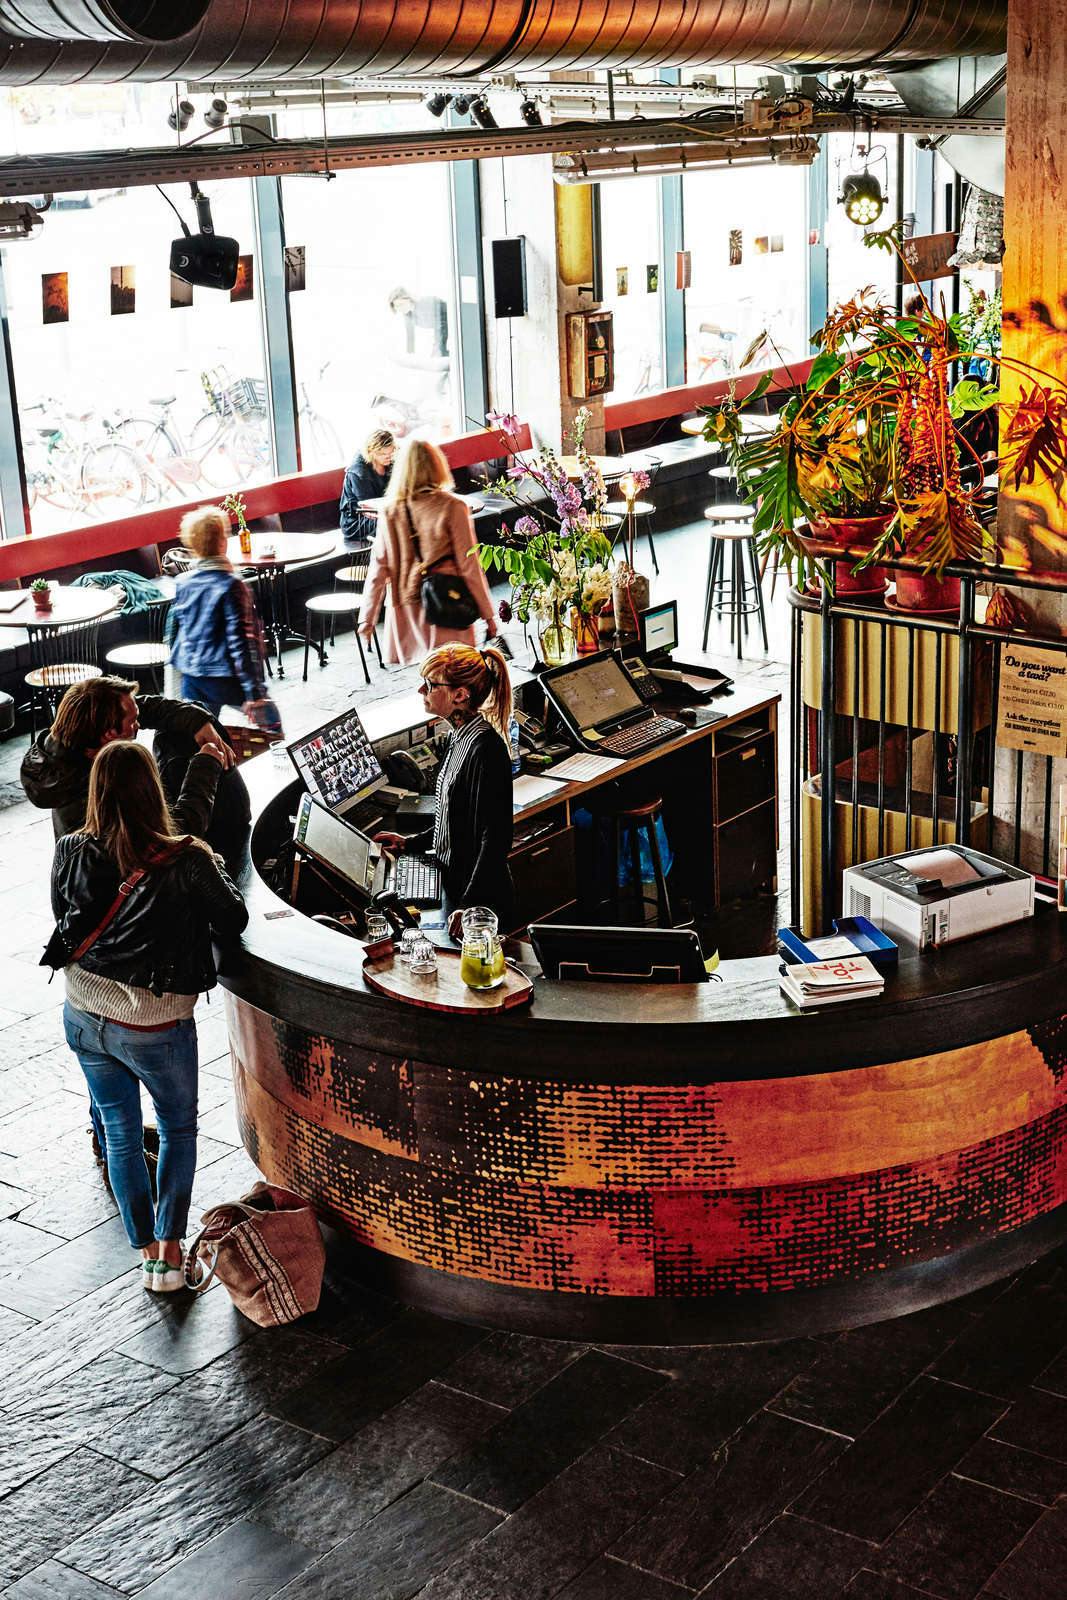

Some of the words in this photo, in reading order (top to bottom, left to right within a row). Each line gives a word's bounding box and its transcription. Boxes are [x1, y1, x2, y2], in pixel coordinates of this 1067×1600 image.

[1005, 656, 1020, 667] Do
[1021, 662, 1041, 671] you
[1042, 665, 1067, 675] want
[1026, 671, 1051, 682] taxi?
[1005, 712, 1017, 720] Ask
[1029, 718, 1060, 728] reception
